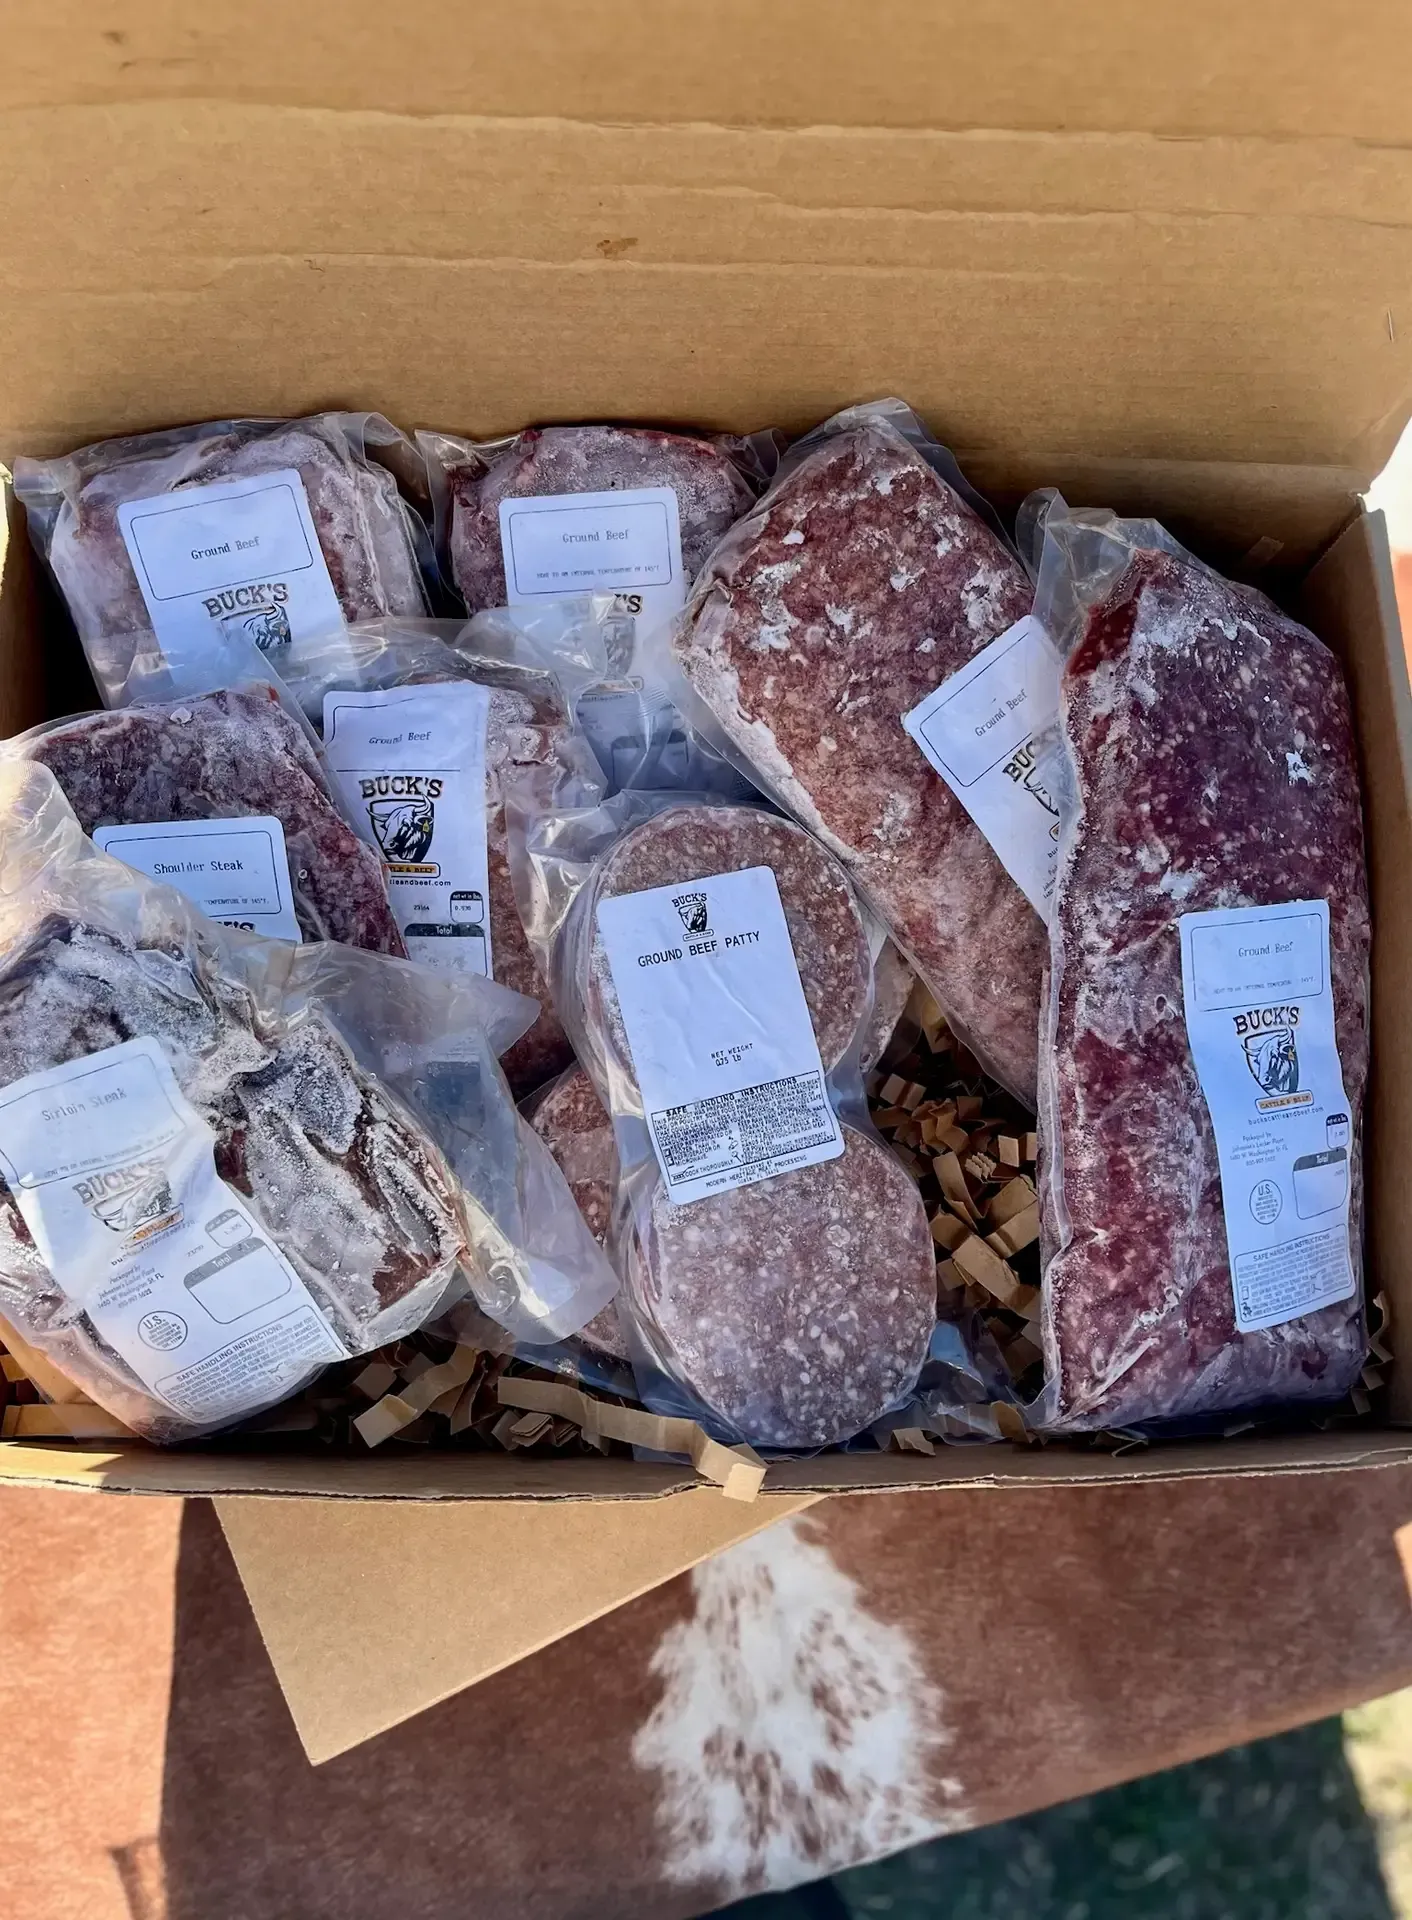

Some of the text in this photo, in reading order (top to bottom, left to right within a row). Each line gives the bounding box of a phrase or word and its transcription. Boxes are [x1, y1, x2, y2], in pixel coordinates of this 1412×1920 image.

[562, 529, 629, 543] Ground Beef
[191, 536, 260, 560] Ground Beef
[201, 582, 288, 618] BUCK'S
[974, 687, 1028, 738] Ground Beef
[369, 731, 432, 745] Ground Beef
[359, 775, 443, 800] BUCK'S
[154, 860, 244, 875] Shoulder Steak
[671, 892, 708, 908] BUCK'S
[436, 925, 453, 935] Total
[638, 948, 683, 968] GROUND
[689, 940, 718, 957] BEEF
[725, 931, 761, 950] PATTY
[1238, 941, 1294, 957] Ground Beef
[1232, 1006, 1300, 1035] BUCK'S
[711, 1042, 753, 1059] NET WEIGHT
[42, 1088, 127, 1121] Sirloin Steak
[665, 1105, 687, 1117] SAFE
[740, 1075, 797, 1097] INSTRUCTIONS
[705, 1154, 807, 1187] MODERN HERITAGE MEAT PROCESSING
[212, 1253, 232, 1268] Total
[1253, 1252, 1269, 1261] SAFE
[154, 1270, 164, 1280] FL
[143, 1314, 166, 1330] U.S.
[176, 1321, 283, 1382] SAFE HANDLING INSTRUCTIONS
